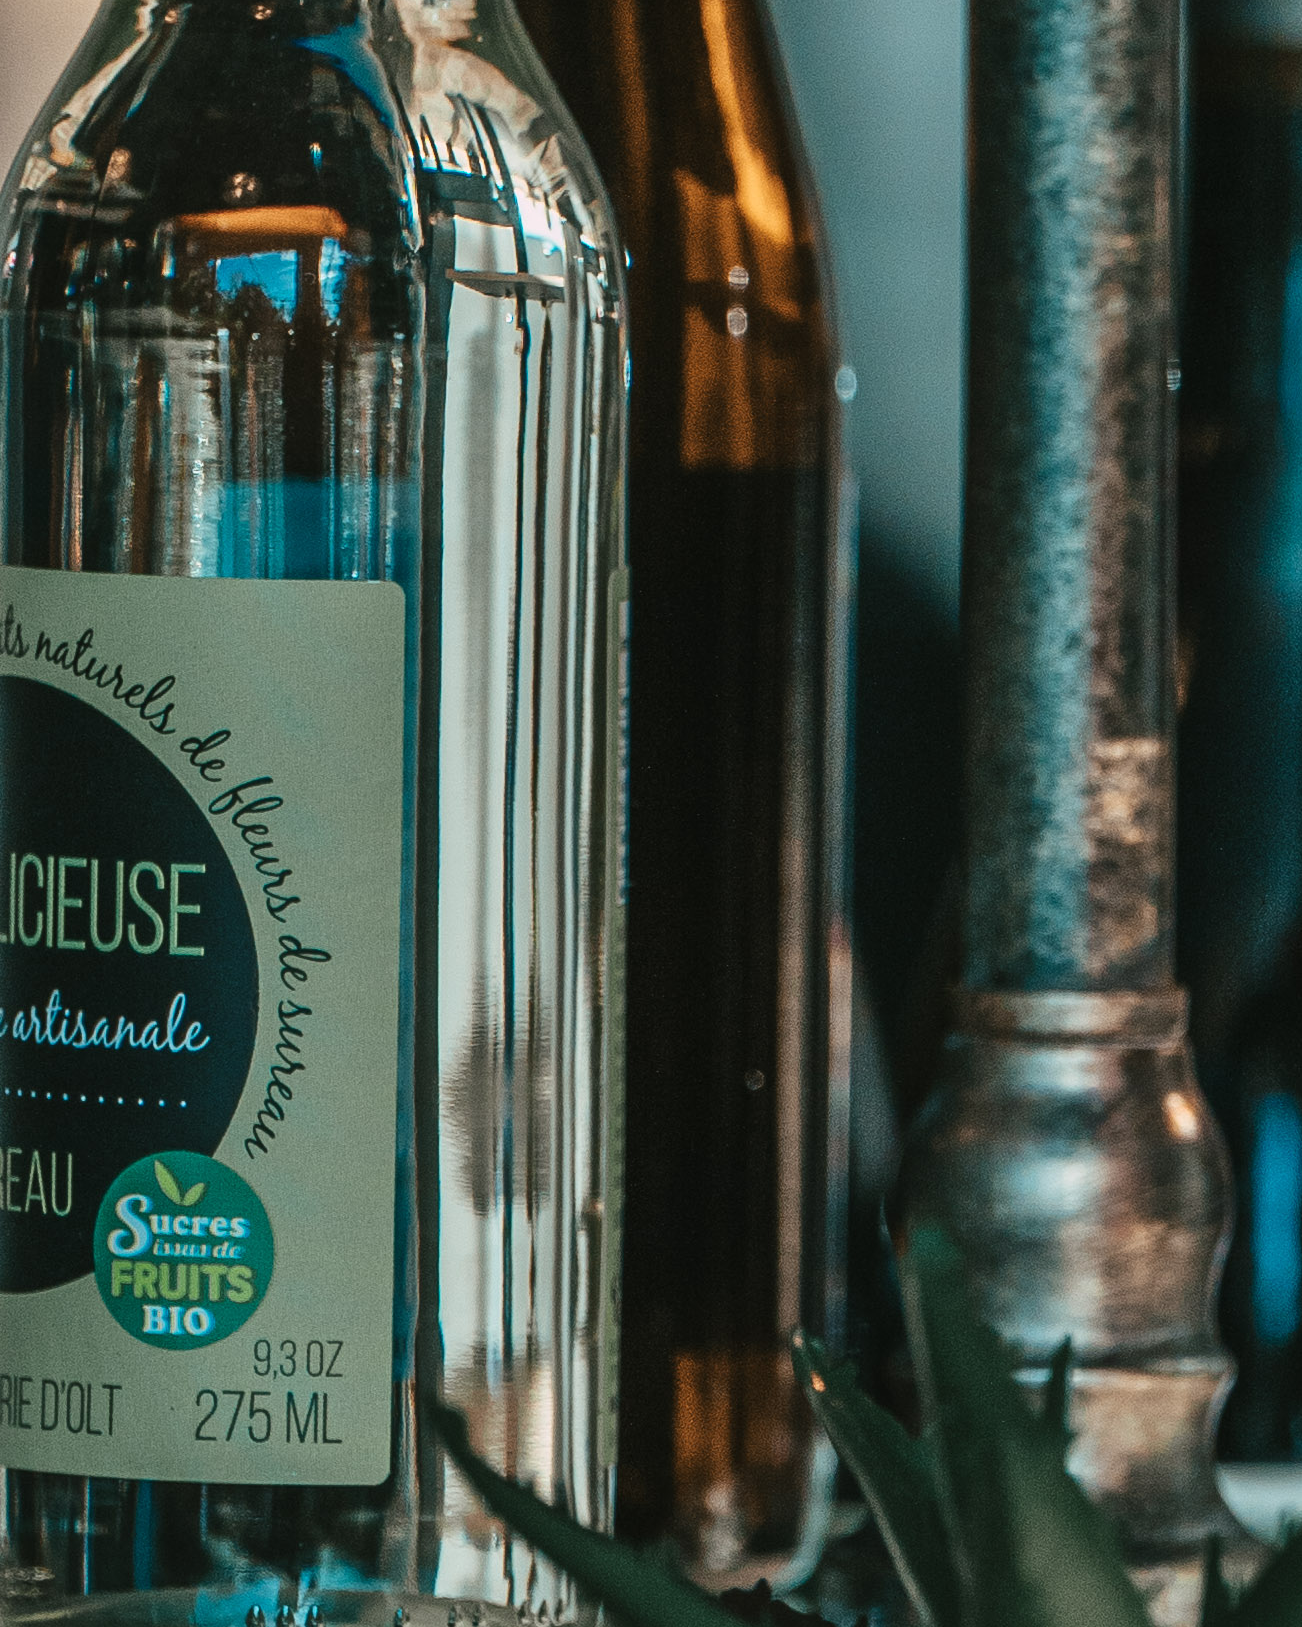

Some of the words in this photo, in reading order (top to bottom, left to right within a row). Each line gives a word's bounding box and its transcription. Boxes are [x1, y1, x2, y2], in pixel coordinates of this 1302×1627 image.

[35, 628, 176, 735] naturels
[179, 729, 231, 782] de
[208, 776, 301, 923] fleurs
[278, 935, 332, 991] de
[12, 987, 211, 1053] artisanale
[244, 999, 312, 1159] sureau
[0, 1145, 73, 1217] EAU
[107, 1193, 250, 1258] Sucres
[212, 1239, 245, 1259] de
[110, 1259, 257, 1304] FRUITS
[142, 1304, 216, 1336] BIO
[253, 1339, 297, 1380] 9,3
[306, 1339, 344, 1378] OZ
[41, 1378, 123, 1437] D'OLT
[194, 1388, 272, 1443] 275
[285, 1390, 343, 1444] ML
